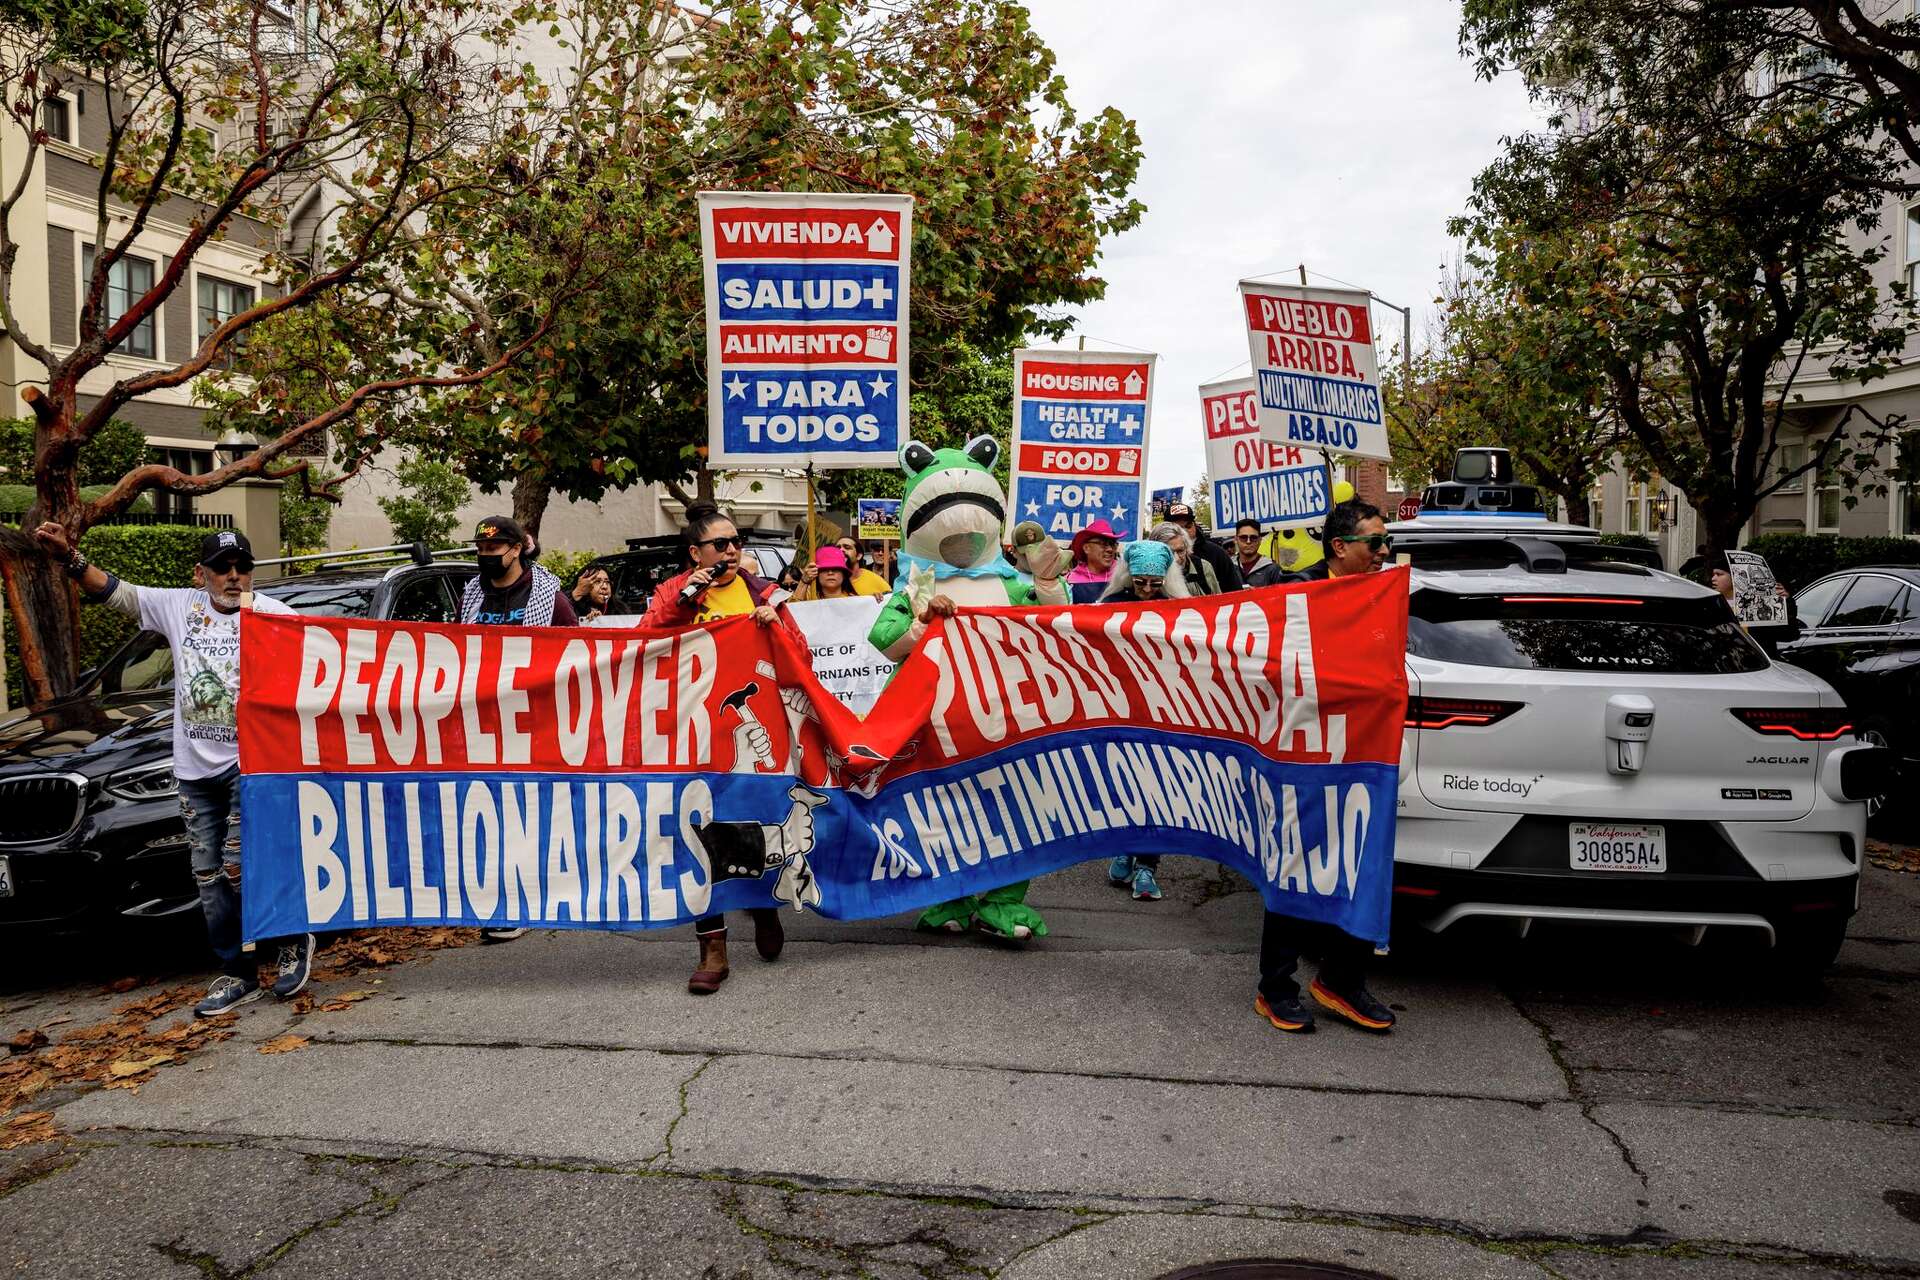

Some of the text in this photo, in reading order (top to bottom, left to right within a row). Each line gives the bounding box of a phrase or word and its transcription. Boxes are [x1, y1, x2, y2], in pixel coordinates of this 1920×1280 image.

[720, 222, 864, 244] VIVIENDA
[723, 278, 861, 310] SALUD
[1259, 298, 1353, 339] PUEBLO
[723, 334, 863, 354] ALIMENTO
[1267, 334, 1364, 382] ARRIBA,
[757, 380, 865, 408] PARA
[1026, 373, 1119, 392] HOUSING
[1261, 373, 1378, 423] MULTIMILLONARIOS
[1039, 405, 1118, 424] HEALTH
[742, 415, 880, 443] TODOS
[1050, 423, 1105, 440] CARE
[1288, 414, 1358, 450] ABAJO
[1042, 451, 1110, 471] FOOD
[1234, 440, 1303, 473] OVER
[1046, 484, 1103, 507] FOR
[1220, 469, 1326, 523] BILLIONAIRES
[840, 645, 856, 655] OF
[1577, 656, 1654, 665] WAYMO
[923, 593, 1348, 764] PUEBLO ARRIBA,
[295, 626, 718, 767] PEOPLE OVER
[1746, 756, 1809, 765] JAGUAR
[1443, 775, 1532, 798] Ride today
[904, 742, 1256, 879] MULTIMILLONARIOS
[1589, 824, 1641, 840] California
[298, 780, 714, 924] BILLIONAIRES
[1577, 841, 1660, 865] 30885A4
